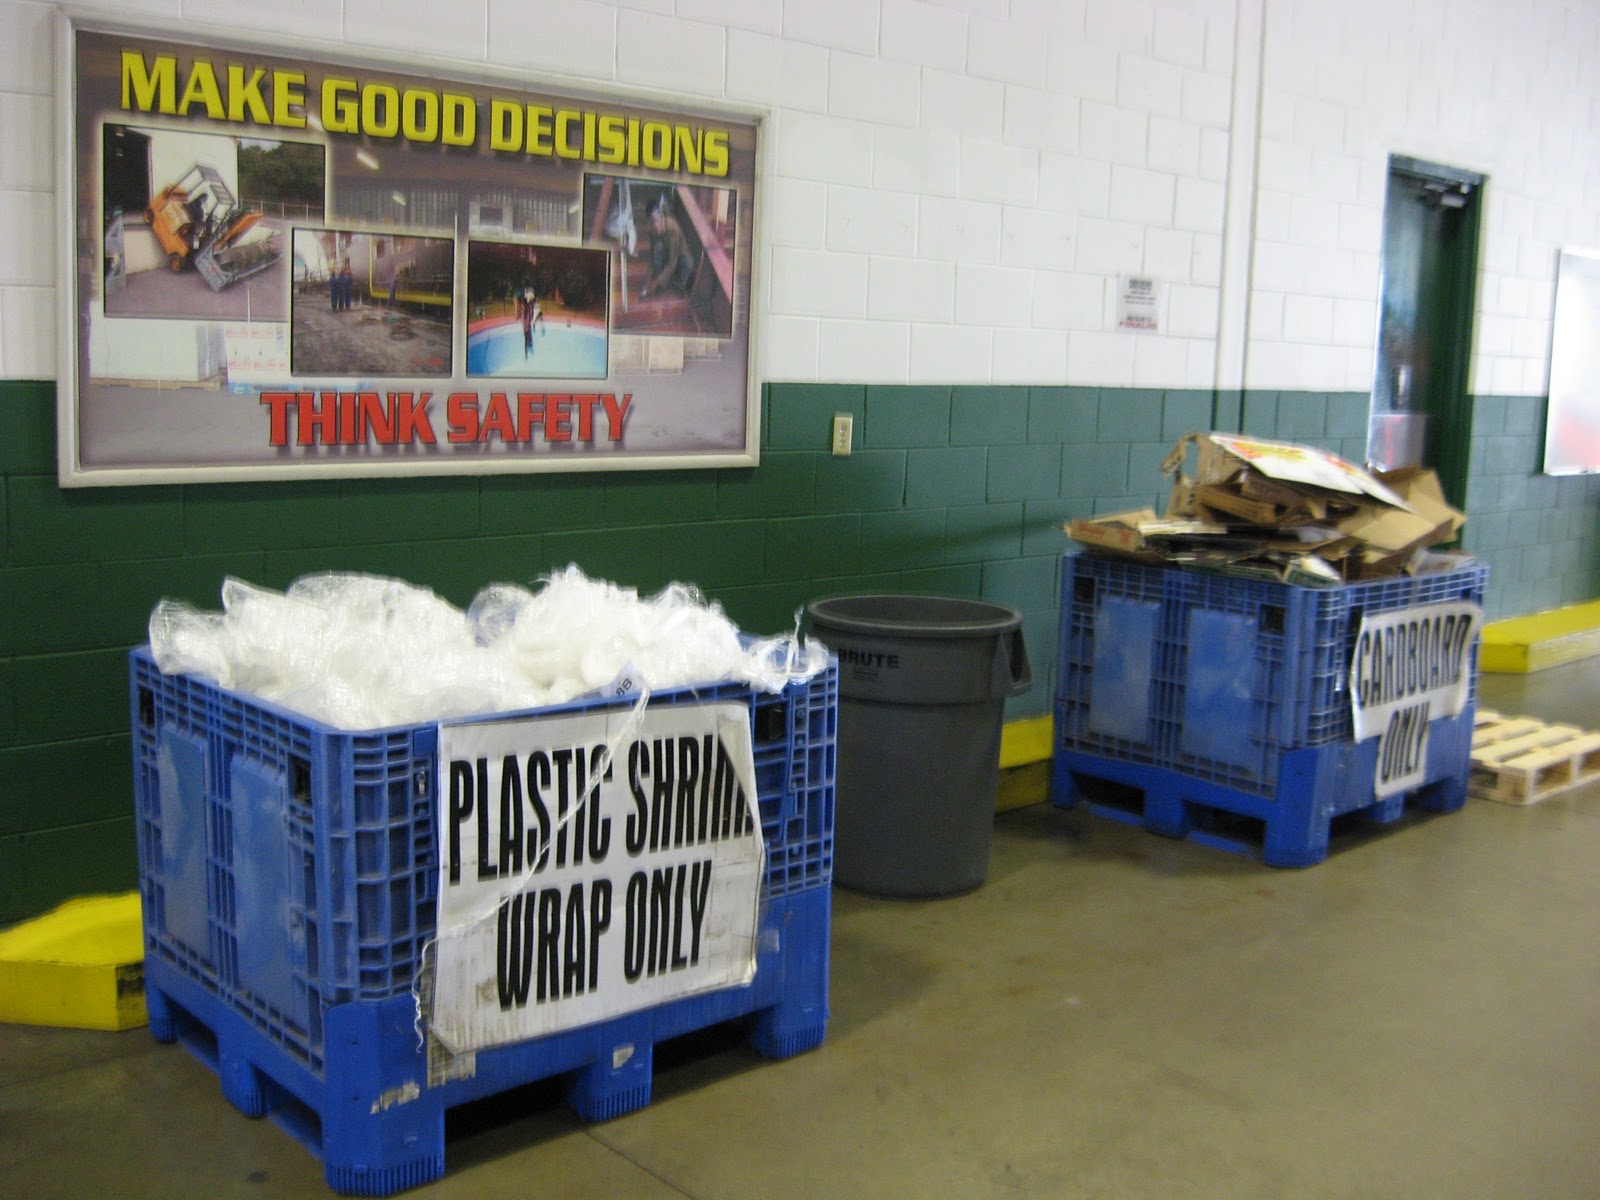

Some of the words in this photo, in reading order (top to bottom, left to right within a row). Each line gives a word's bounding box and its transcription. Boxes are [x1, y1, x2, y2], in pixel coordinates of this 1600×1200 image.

[120, 50, 307, 129] MAKE
[320, 77, 477, 147] GOOD
[490, 98, 731, 178] DECISIONS
[260, 392, 437, 447] THINK
[447, 392, 632, 444] SAFETY
[1356, 613, 1473, 711] CARDBOARD
[1381, 702, 1430, 784] ONLY
[449, 744, 613, 887] PLASTIC
[499, 878, 613, 1013] WRAP
[624, 859, 712, 983] ONLY
